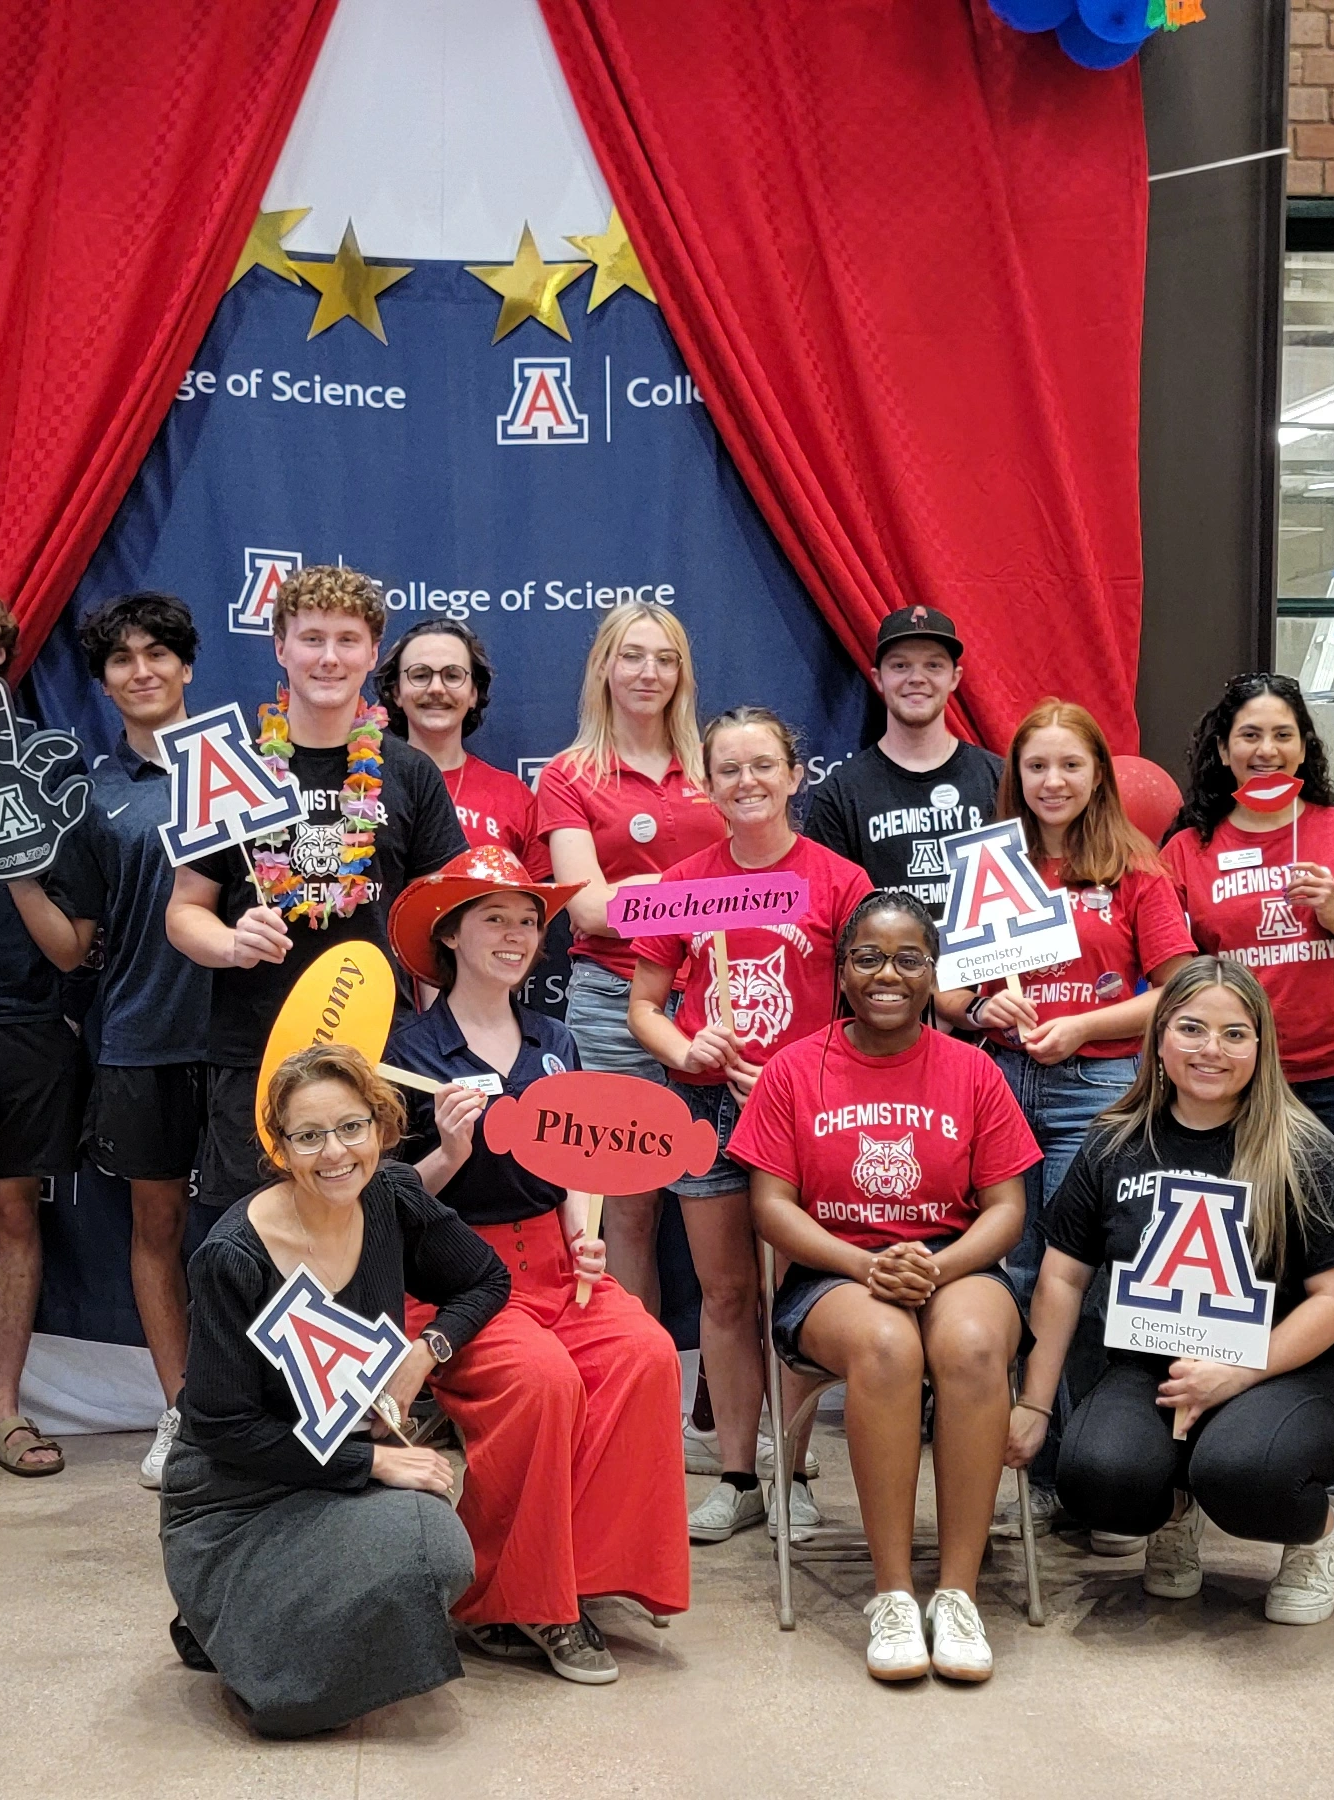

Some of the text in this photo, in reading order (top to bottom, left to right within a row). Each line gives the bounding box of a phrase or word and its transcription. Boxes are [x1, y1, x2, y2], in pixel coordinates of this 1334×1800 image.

[226, 368, 264, 399] of
[271, 370, 407, 409] Science
[496, 357, 589, 446] A
[626, 375, 706, 408] Coll
[500, 581, 536, 611] of
[544, 580, 675, 611] Science
[159, 707, 304, 861] A
[485, 816, 500, 840] &
[868, 805, 983, 843] CHEMISTRY &
[939, 822, 1068, 956] A
[1212, 865, 1292, 904] CHEMIST
[620, 887, 800, 924] Biochemistry
[1256, 897, 1303, 941] A
[956, 945, 1023, 970] Chemistry
[960, 951, 1059, 983] & Biochemistry
[532, 1108, 673, 1158] Physics
[814, 1102, 958, 1141] CHEMISTRY &
[817, 1201, 954, 1224] BIOCHEMISTRY
[1116, 1176, 1268, 1325] A
[1131, 1316, 1208, 1342] Chemistry
[253, 1270, 407, 1457] A
[1129, 1333, 1244, 1364] & Biochemistry
